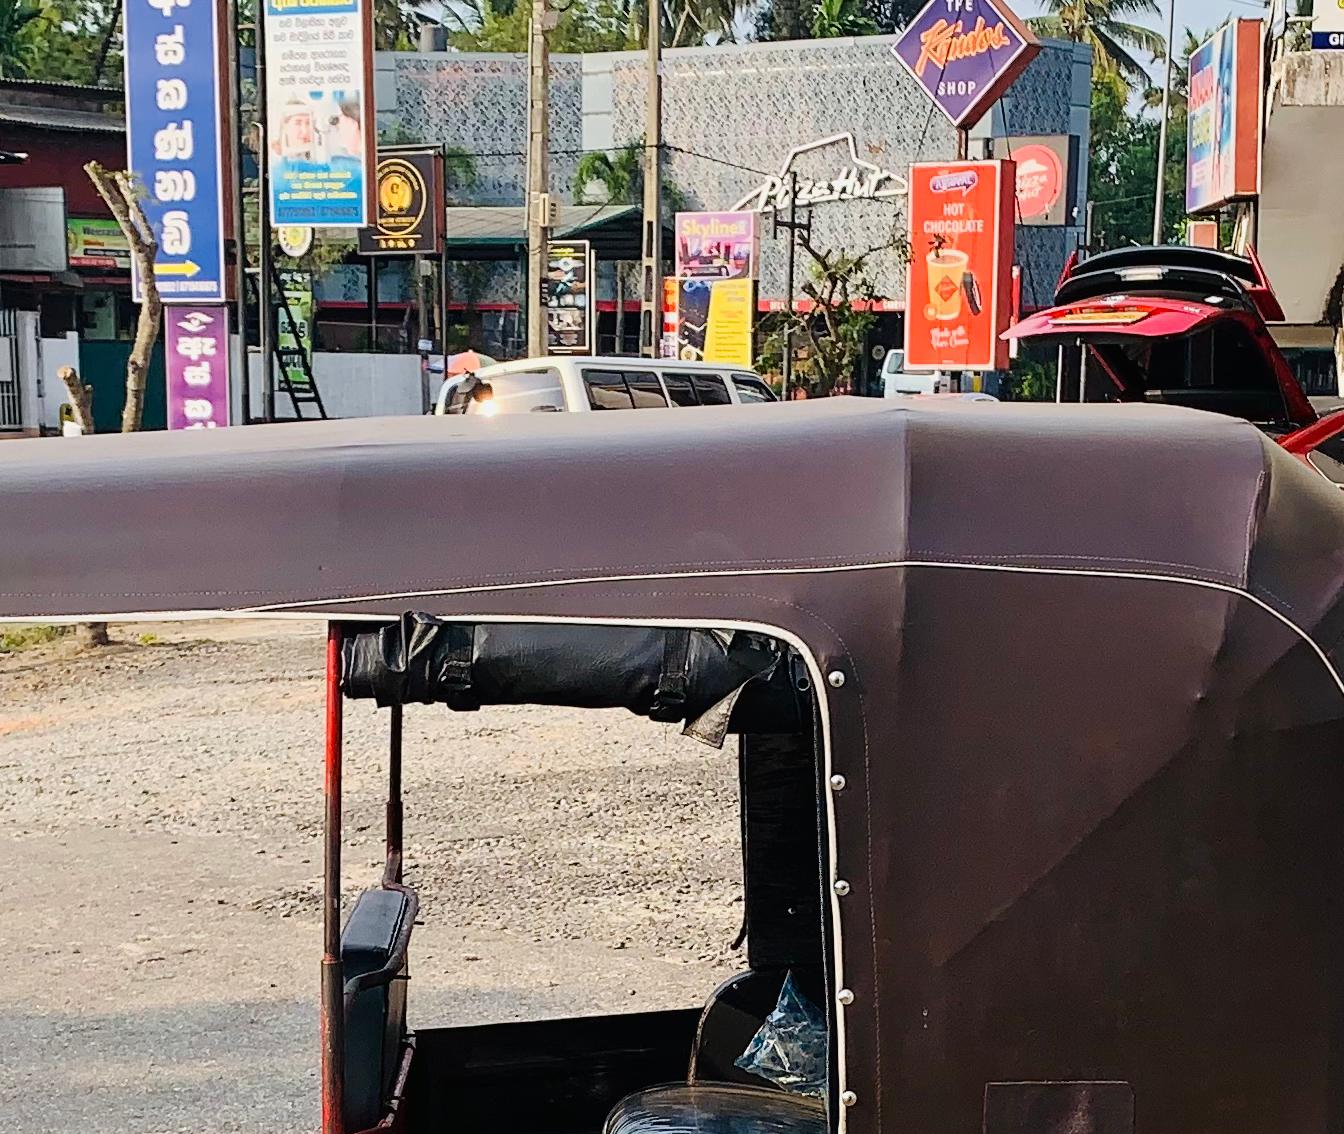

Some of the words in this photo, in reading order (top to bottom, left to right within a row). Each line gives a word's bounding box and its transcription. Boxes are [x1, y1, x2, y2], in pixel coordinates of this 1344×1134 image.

[937, 80, 977, 96] SHOP
[943, 204, 965, 216] HOT
[923, 219, 985, 234] CHOCOLATE
